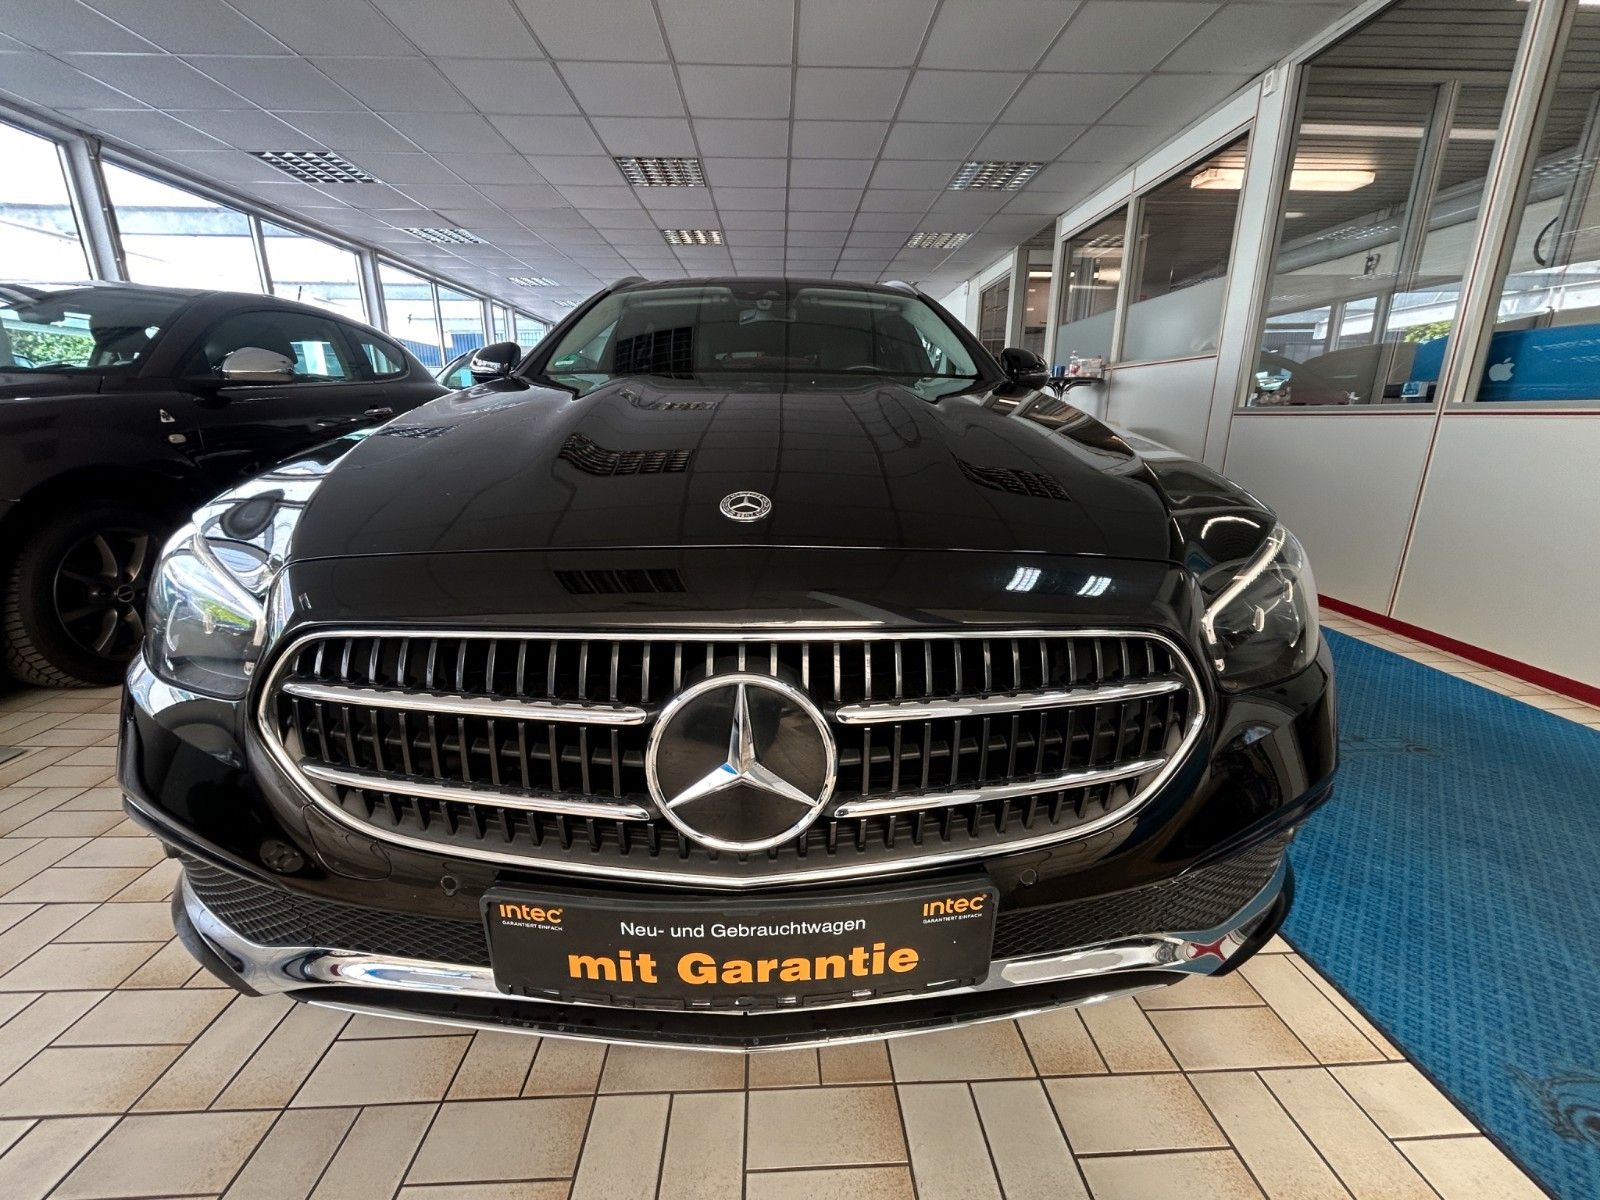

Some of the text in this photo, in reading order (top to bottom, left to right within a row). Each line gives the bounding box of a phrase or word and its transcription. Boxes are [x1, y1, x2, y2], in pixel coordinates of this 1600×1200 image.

[620, 918, 866, 938] Neu- und Gebrauchtwagen
[567, 942, 920, 985] mit Garantie
